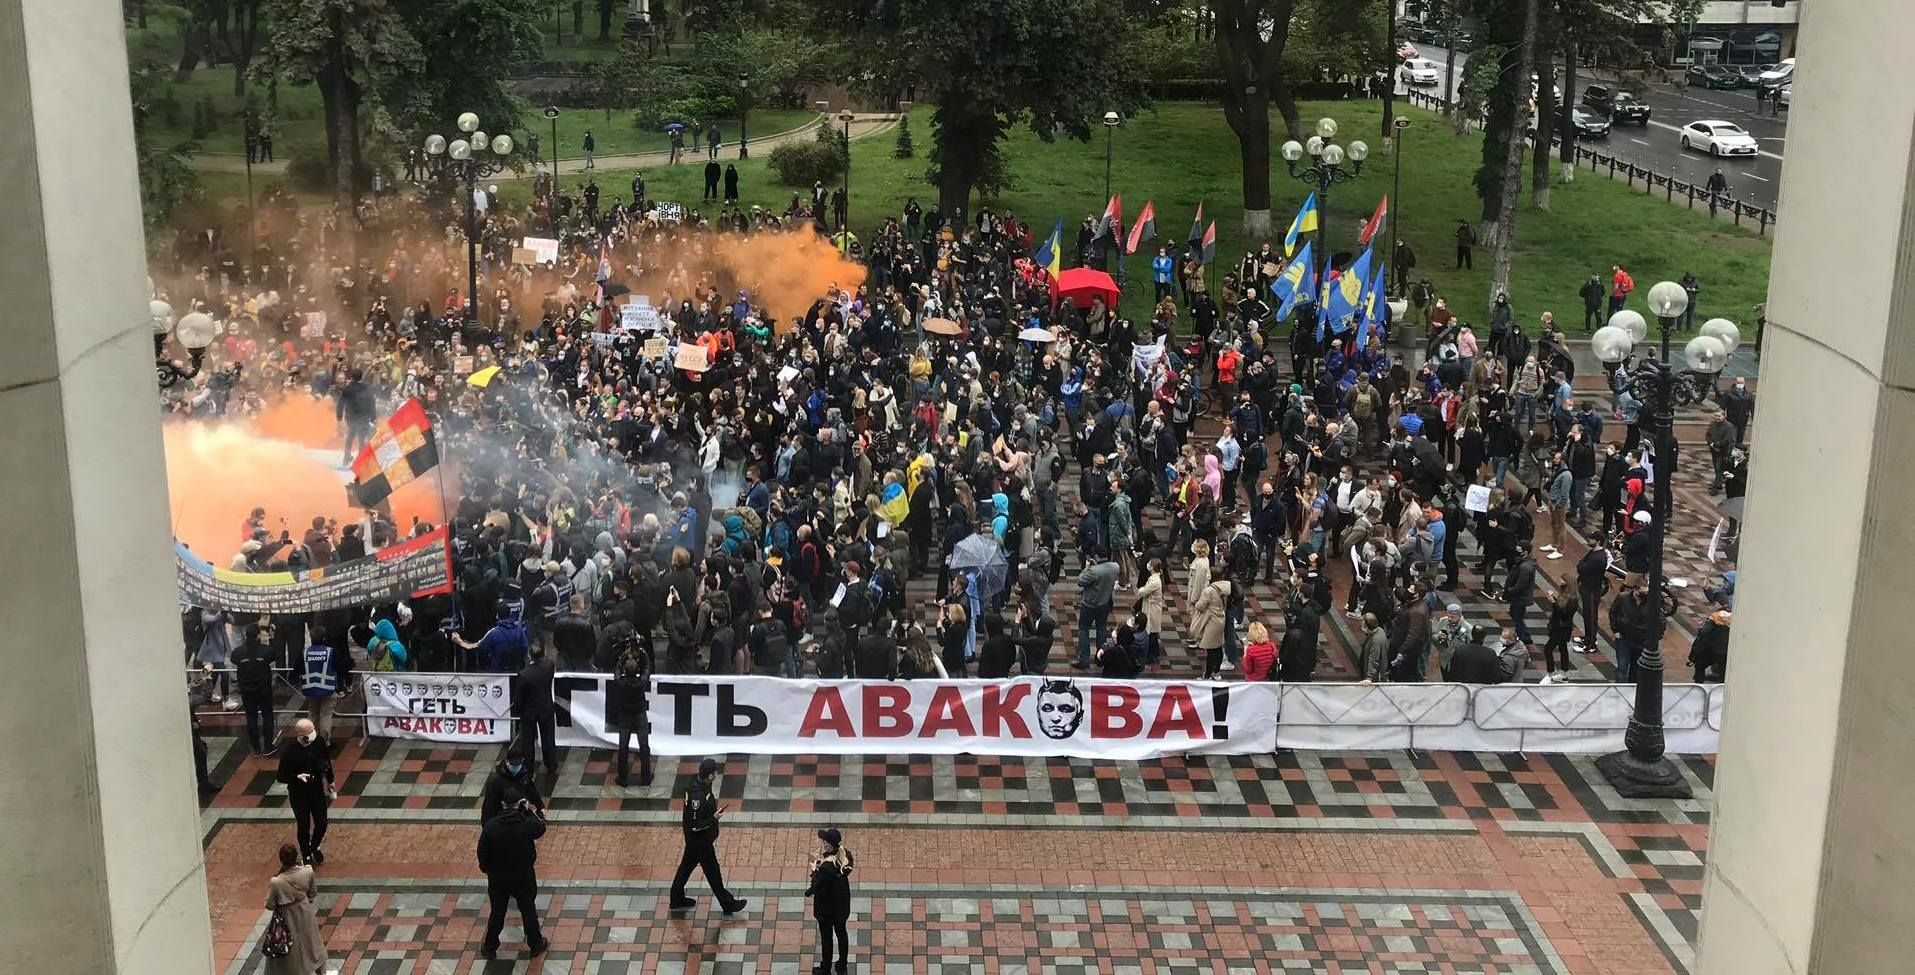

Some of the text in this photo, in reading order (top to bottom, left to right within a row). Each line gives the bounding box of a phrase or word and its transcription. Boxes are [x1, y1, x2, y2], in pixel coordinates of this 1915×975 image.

[408, 697, 466, 715] ГЕТЬ
[798, 677, 1230, 740] АВАКВА!
[384, 716, 496, 736] АВАКВА!
